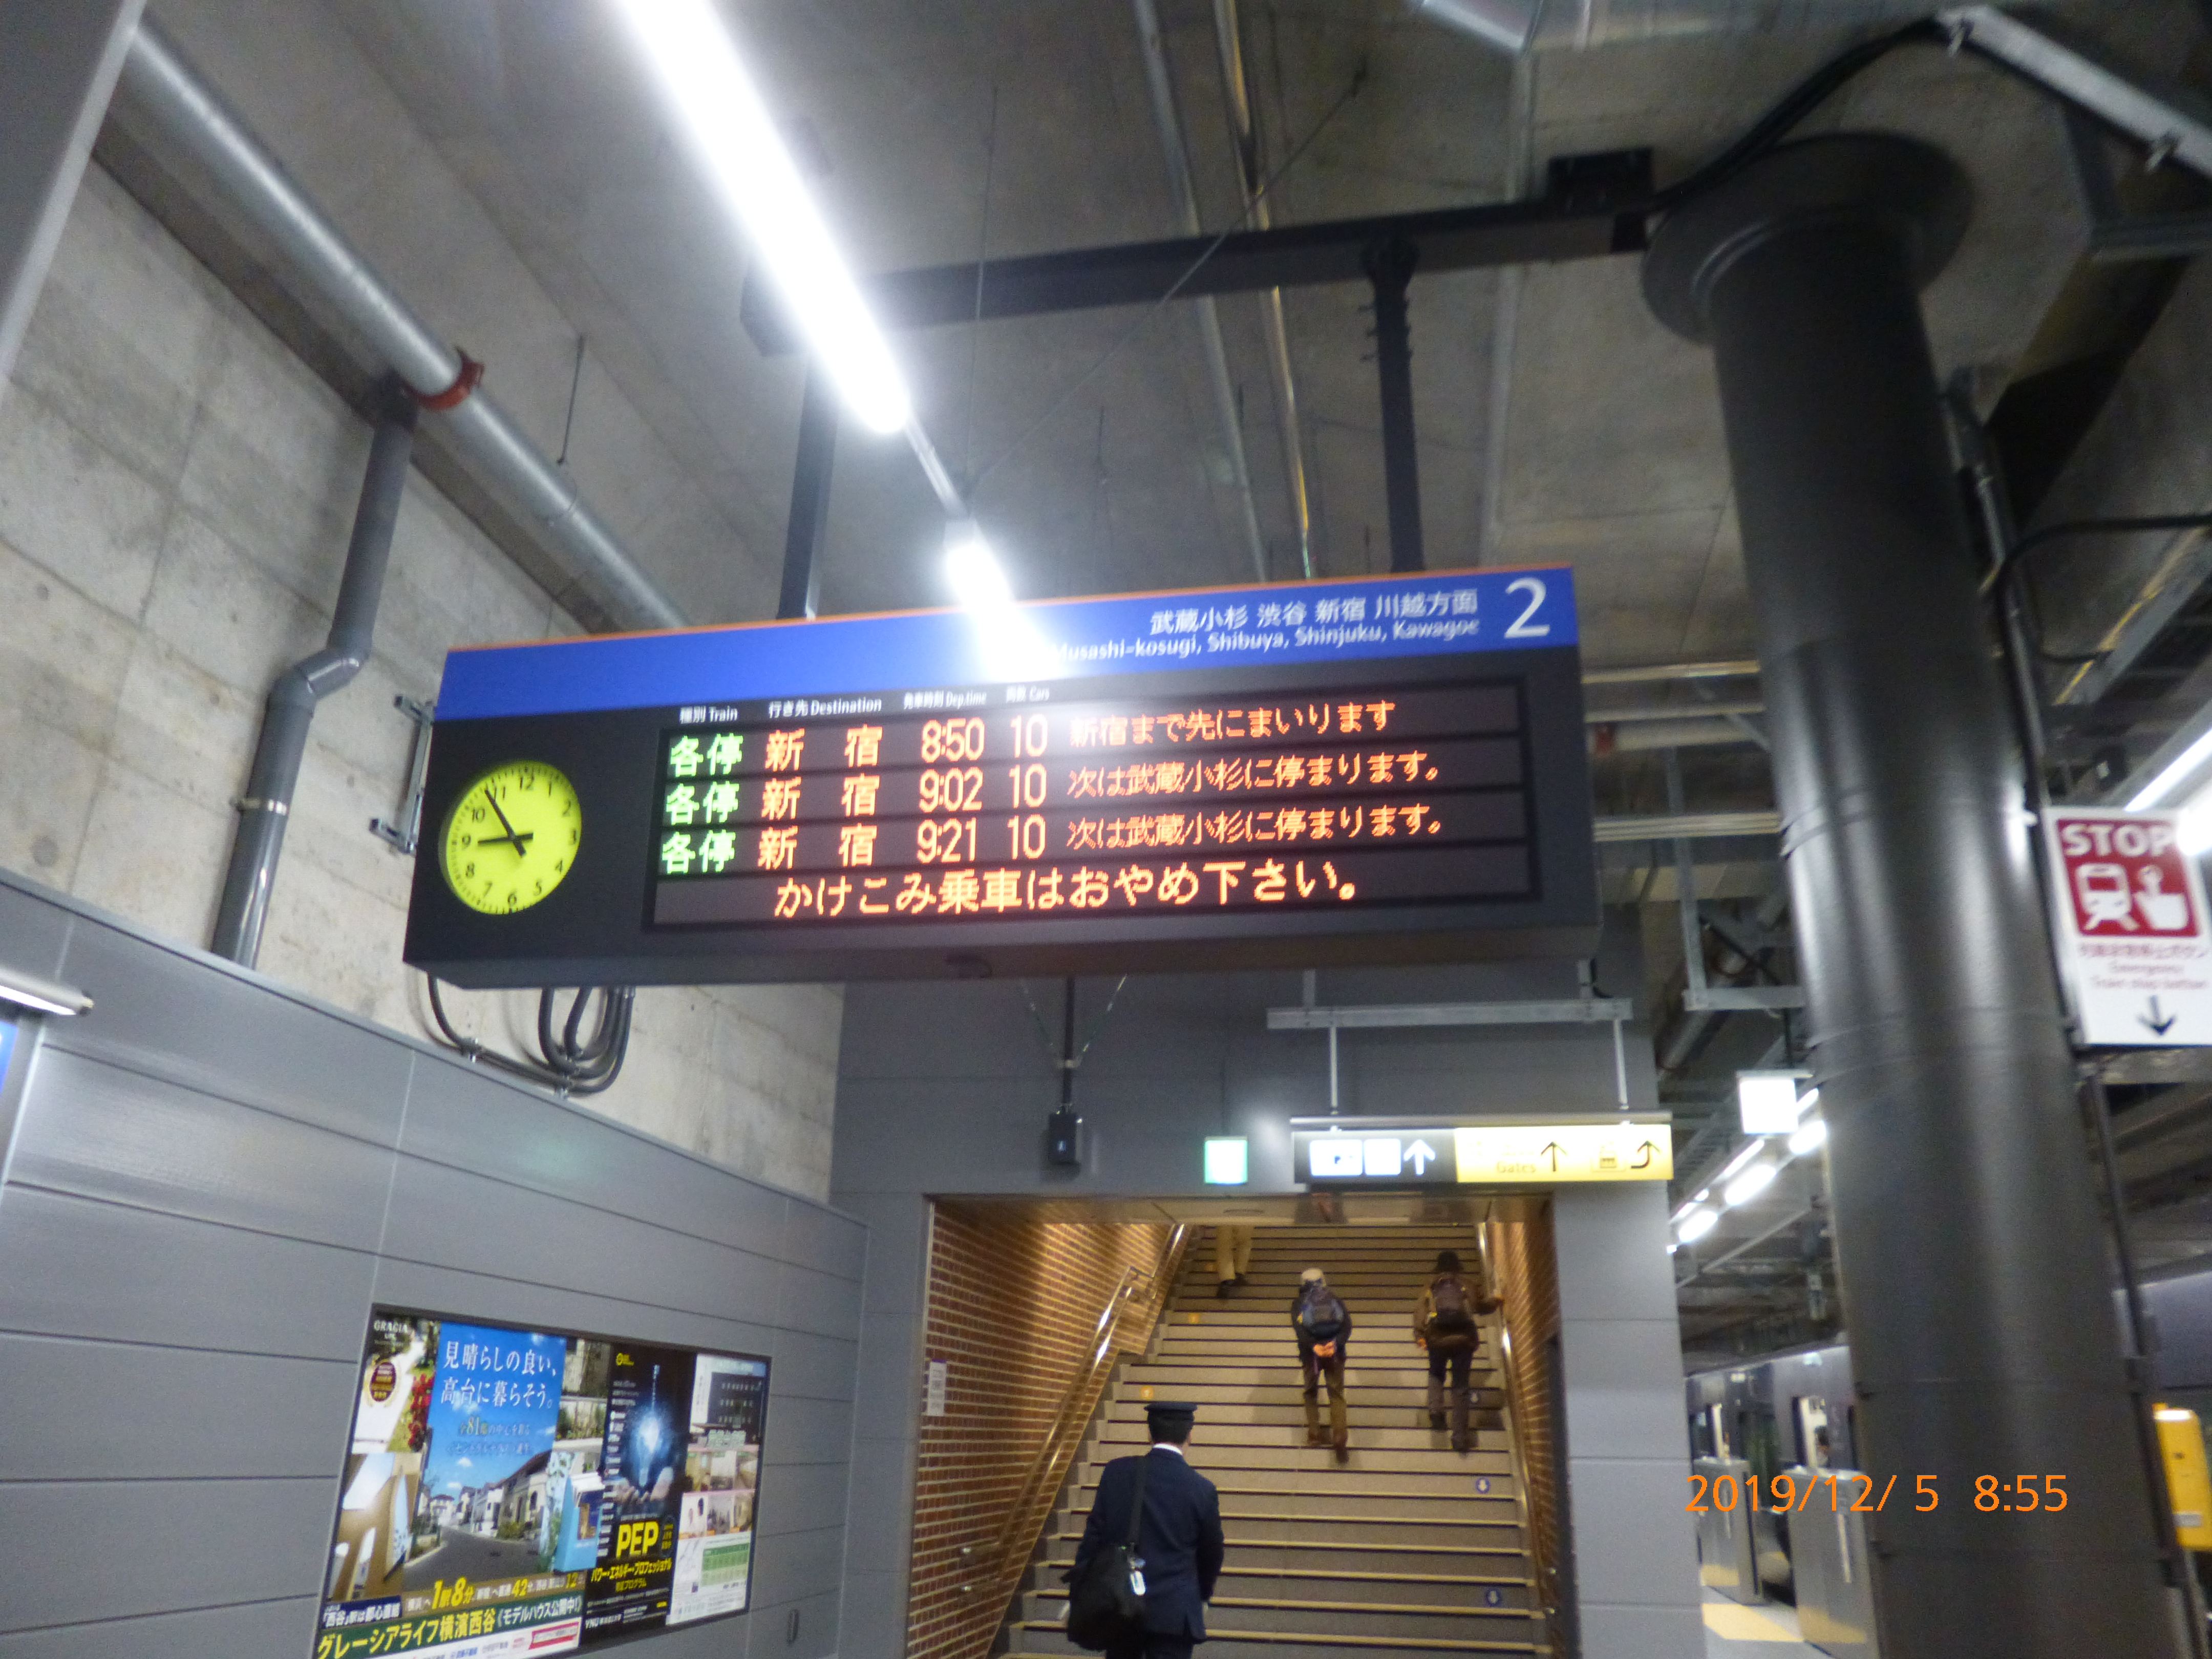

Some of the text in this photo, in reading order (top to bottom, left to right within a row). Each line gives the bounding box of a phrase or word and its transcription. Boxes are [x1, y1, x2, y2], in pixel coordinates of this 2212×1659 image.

[1150, 588, 1477, 635] 武蔵小杉 渋谷 新宿 川越方面
[1505, 577, 1550, 639] 2
[1207, 630, 1289, 653] Shibuya,
[1295, 623, 1387, 648] Shinjuku,
[1393, 620, 1480, 641] Kawagoe
[1029, 686, 1050, 701] Cars
[709, 706, 737, 722] Train
[811, 697, 882, 716] Destination
[670, 732, 743, 777] 各停
[922, 717, 985, 762] 8:50
[1010, 714, 1048, 758] 10
[1070, 700, 1395, 747] 新宿まで先にまいります
[519, 770, 535, 791] 12
[665, 781, 739, 825] 各停
[919, 767, 983, 813] 9:02
[1009, 763, 1047, 809] 10
[1068, 750, 1438, 798] 次は武蔵小杉に停まります。
[472, 807, 485, 823] 10
[462, 834, 471, 847] 9
[662, 830, 736, 874] 各停
[917, 817, 976, 864] 9:21
[1007, 814, 1046, 860] 10
[1067, 803, 1440, 850] 次は武蔵小杉に停まります。
[2061, 824, 2173, 857] STOP
[465, 862, 475, 879] 8
[555, 860, 563, 874] 4
[483, 881, 493, 898] 7
[507, 891, 517, 906] 6
[775, 858, 1355, 918] かけこみ乗車はおやめ下さい。
[1497, 1160, 1536, 1174] Gates
[374, 1320, 408, 1332] GRACIA
[443, 1341, 556, 1376] 見晴らしの良い、
[441, 1376, 552, 1409] 高台に暮らそう。
[616, 1521, 660, 1559] PEP
